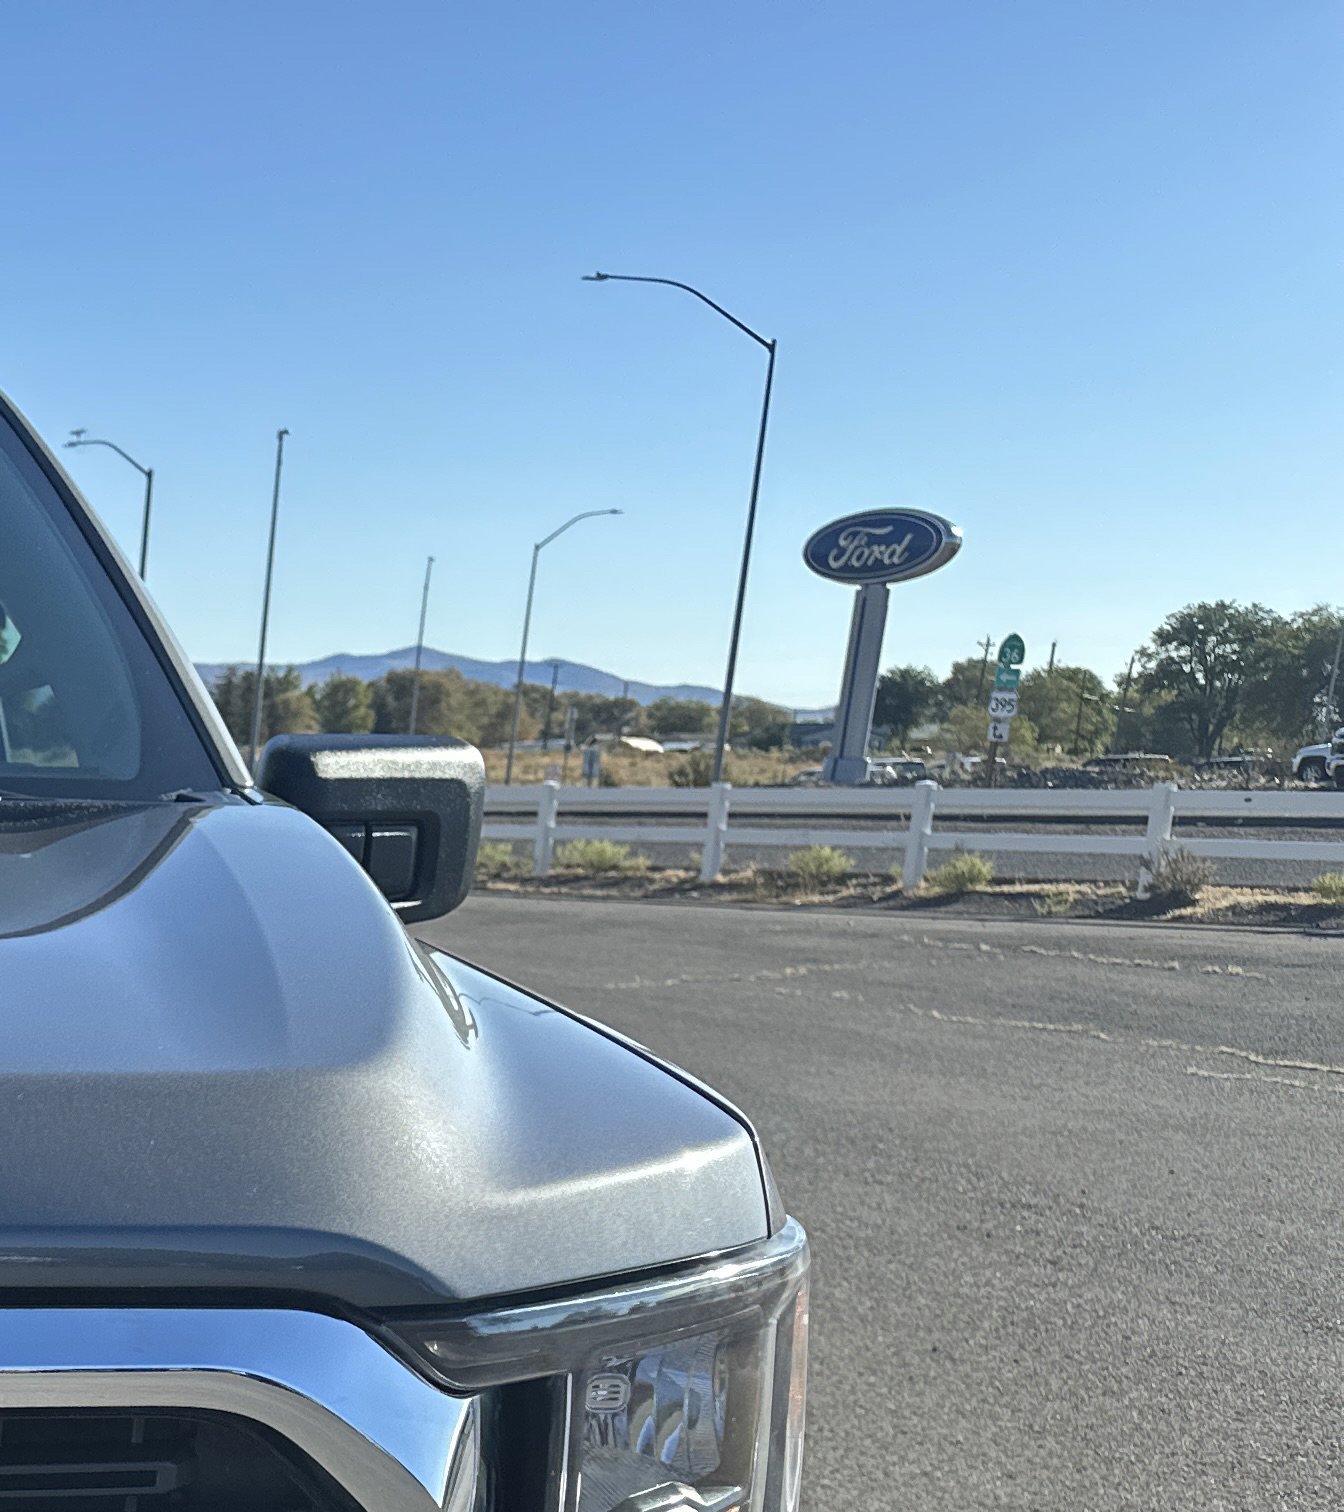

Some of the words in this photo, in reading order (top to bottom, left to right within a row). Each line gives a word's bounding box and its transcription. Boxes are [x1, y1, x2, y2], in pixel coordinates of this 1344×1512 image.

[827, 525, 913, 570] Ford
[1002, 647, 1020, 663] 36
[991, 697, 1015, 714] 395
